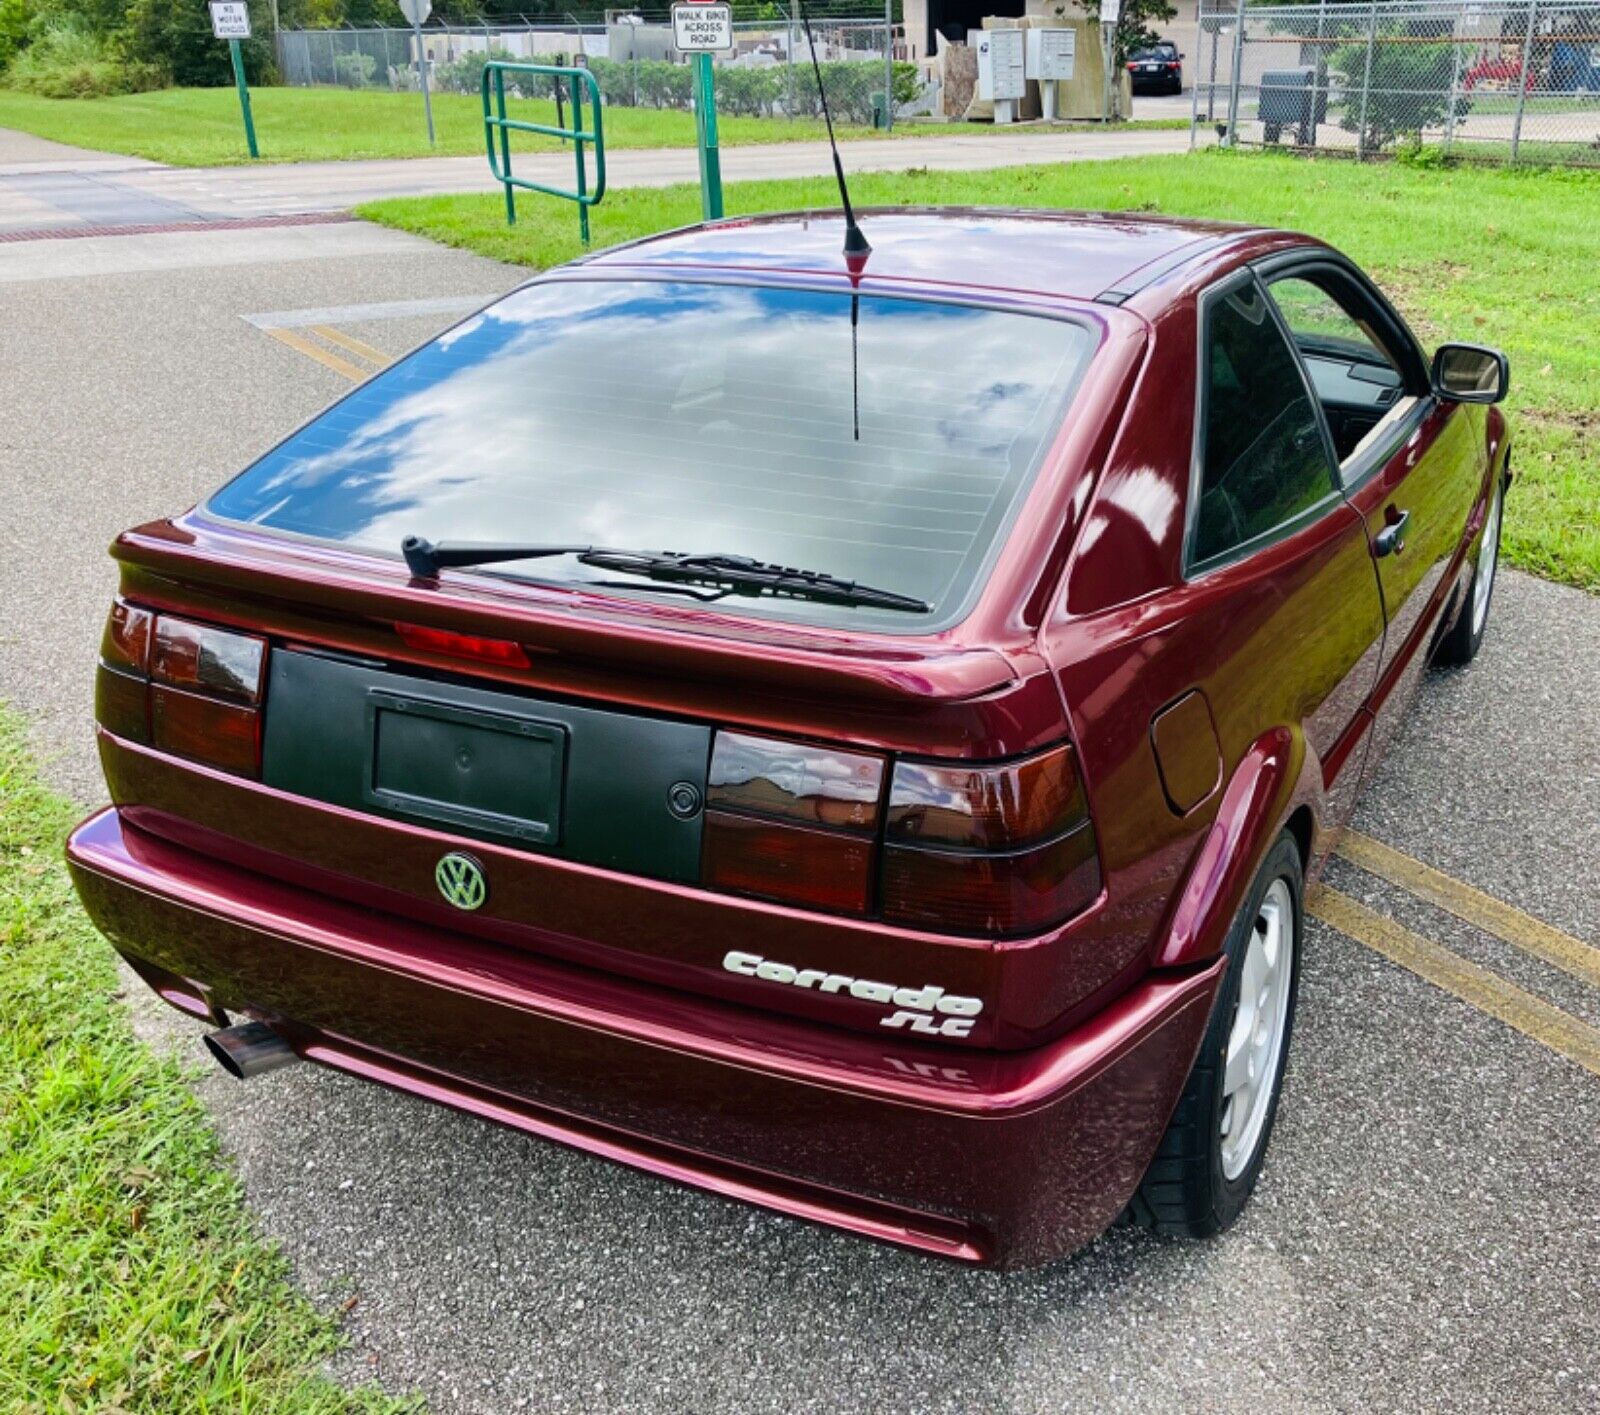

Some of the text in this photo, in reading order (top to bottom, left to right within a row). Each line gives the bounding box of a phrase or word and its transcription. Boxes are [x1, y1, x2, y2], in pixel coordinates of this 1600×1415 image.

[677, 11, 727, 21] WALK BIKE
[684, 22, 723, 32] ACROSS
[691, 34, 717, 44] ROAD
[436, 856, 485, 910] VW
[722, 951, 983, 1016] Corrado
